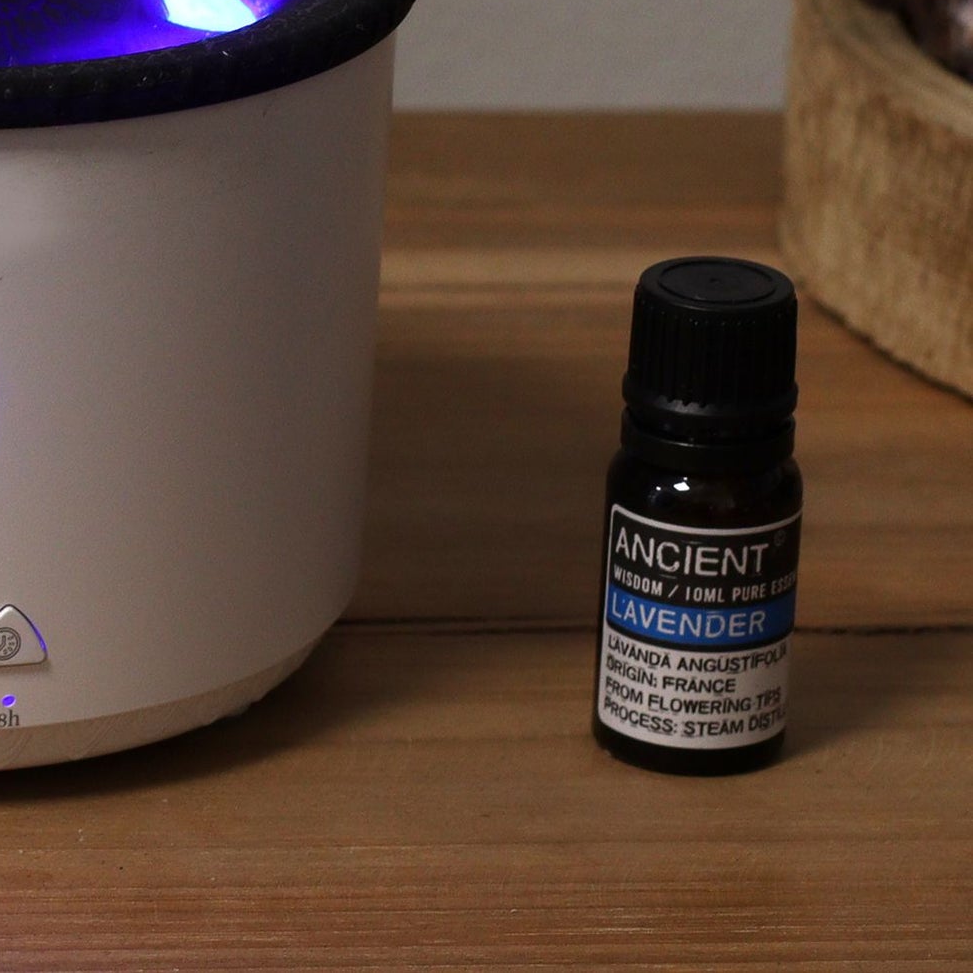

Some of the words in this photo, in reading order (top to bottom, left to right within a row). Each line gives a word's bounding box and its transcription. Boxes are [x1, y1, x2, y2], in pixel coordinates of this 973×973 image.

[616, 526, 770, 576] ANCIENT
[613, 563, 663, 597] WISDOM
[686, 586, 726, 603] 10ML
[731, 582, 767, 603] PURE
[611, 592, 767, 638] LAVENDER
[608, 634, 671, 668] LAVANDA
[606, 654, 658, 688] ORIGIN:
[662, 676, 737, 694] FRANCE
[605, 676, 644, 705] FROM
[648, 694, 752, 714] FLOWERING
[756, 686, 782, 709] TIPS
[603, 696, 678, 734] PROCESS:
[683, 720, 744, 737] STEAM
